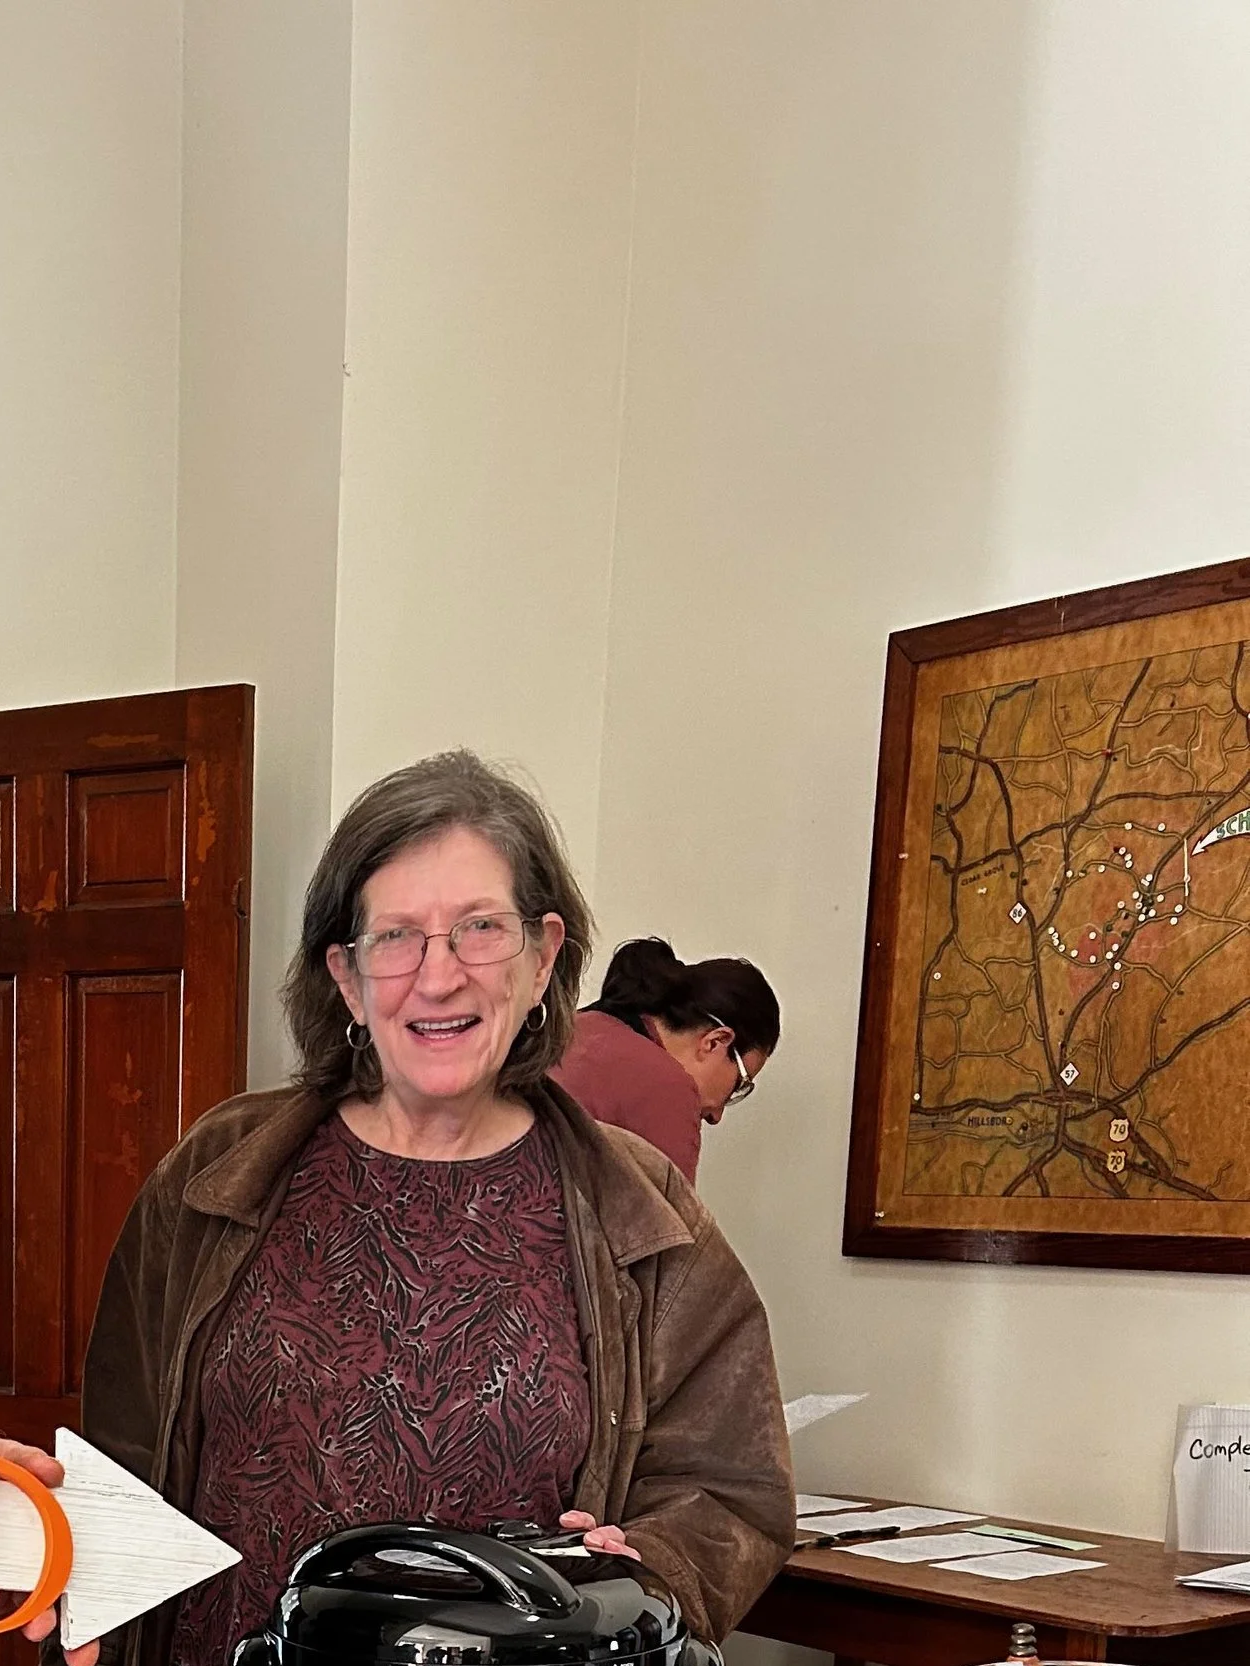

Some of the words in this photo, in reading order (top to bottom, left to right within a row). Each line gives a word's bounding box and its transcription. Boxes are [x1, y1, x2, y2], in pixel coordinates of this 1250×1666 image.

[1012, 908, 1023, 919] 86
[1064, 1069, 1075, 1079] 57
[1113, 1124, 1125, 1134] 70
[1110, 1155, 1122, 1165] 70
